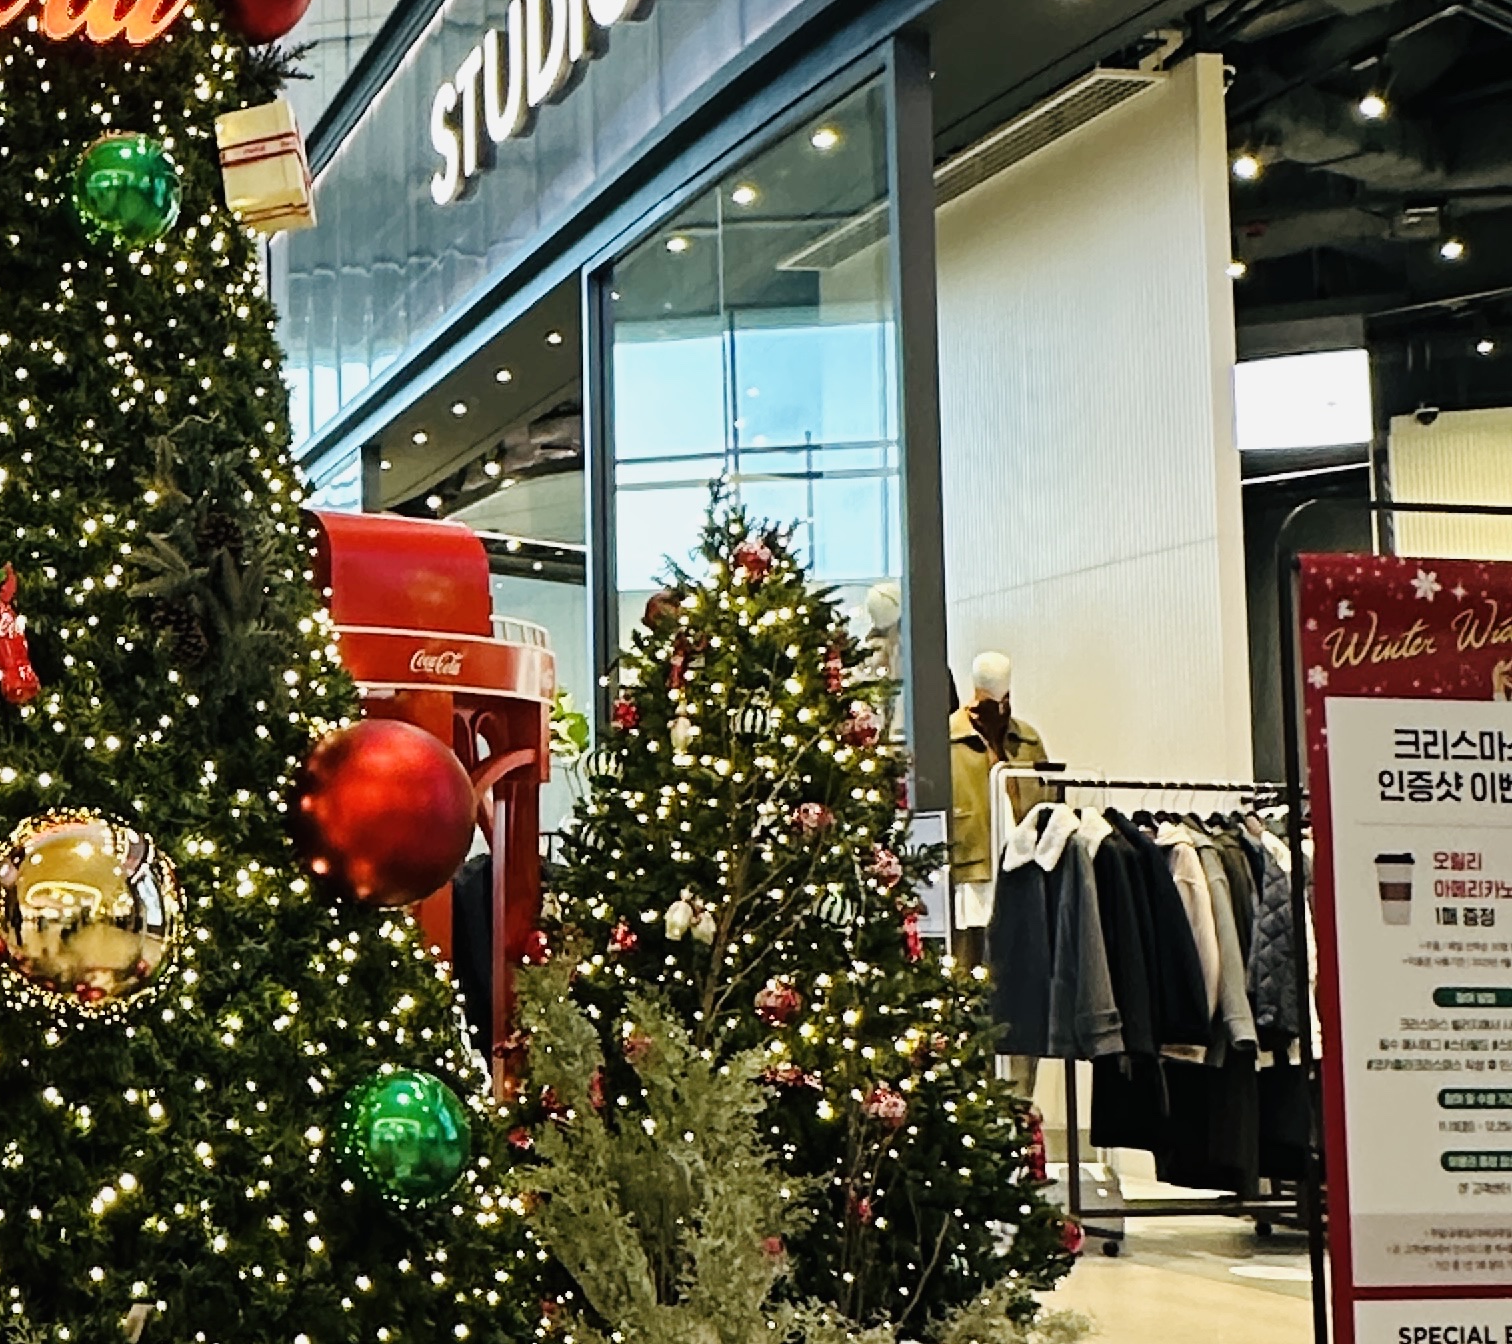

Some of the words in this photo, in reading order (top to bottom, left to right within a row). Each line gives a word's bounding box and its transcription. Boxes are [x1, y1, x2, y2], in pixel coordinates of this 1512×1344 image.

[1322, 610, 1438, 669] Winter
[1394, 728, 1512, 762] 크리스마
[1378, 770, 1464, 803] 인증샷
